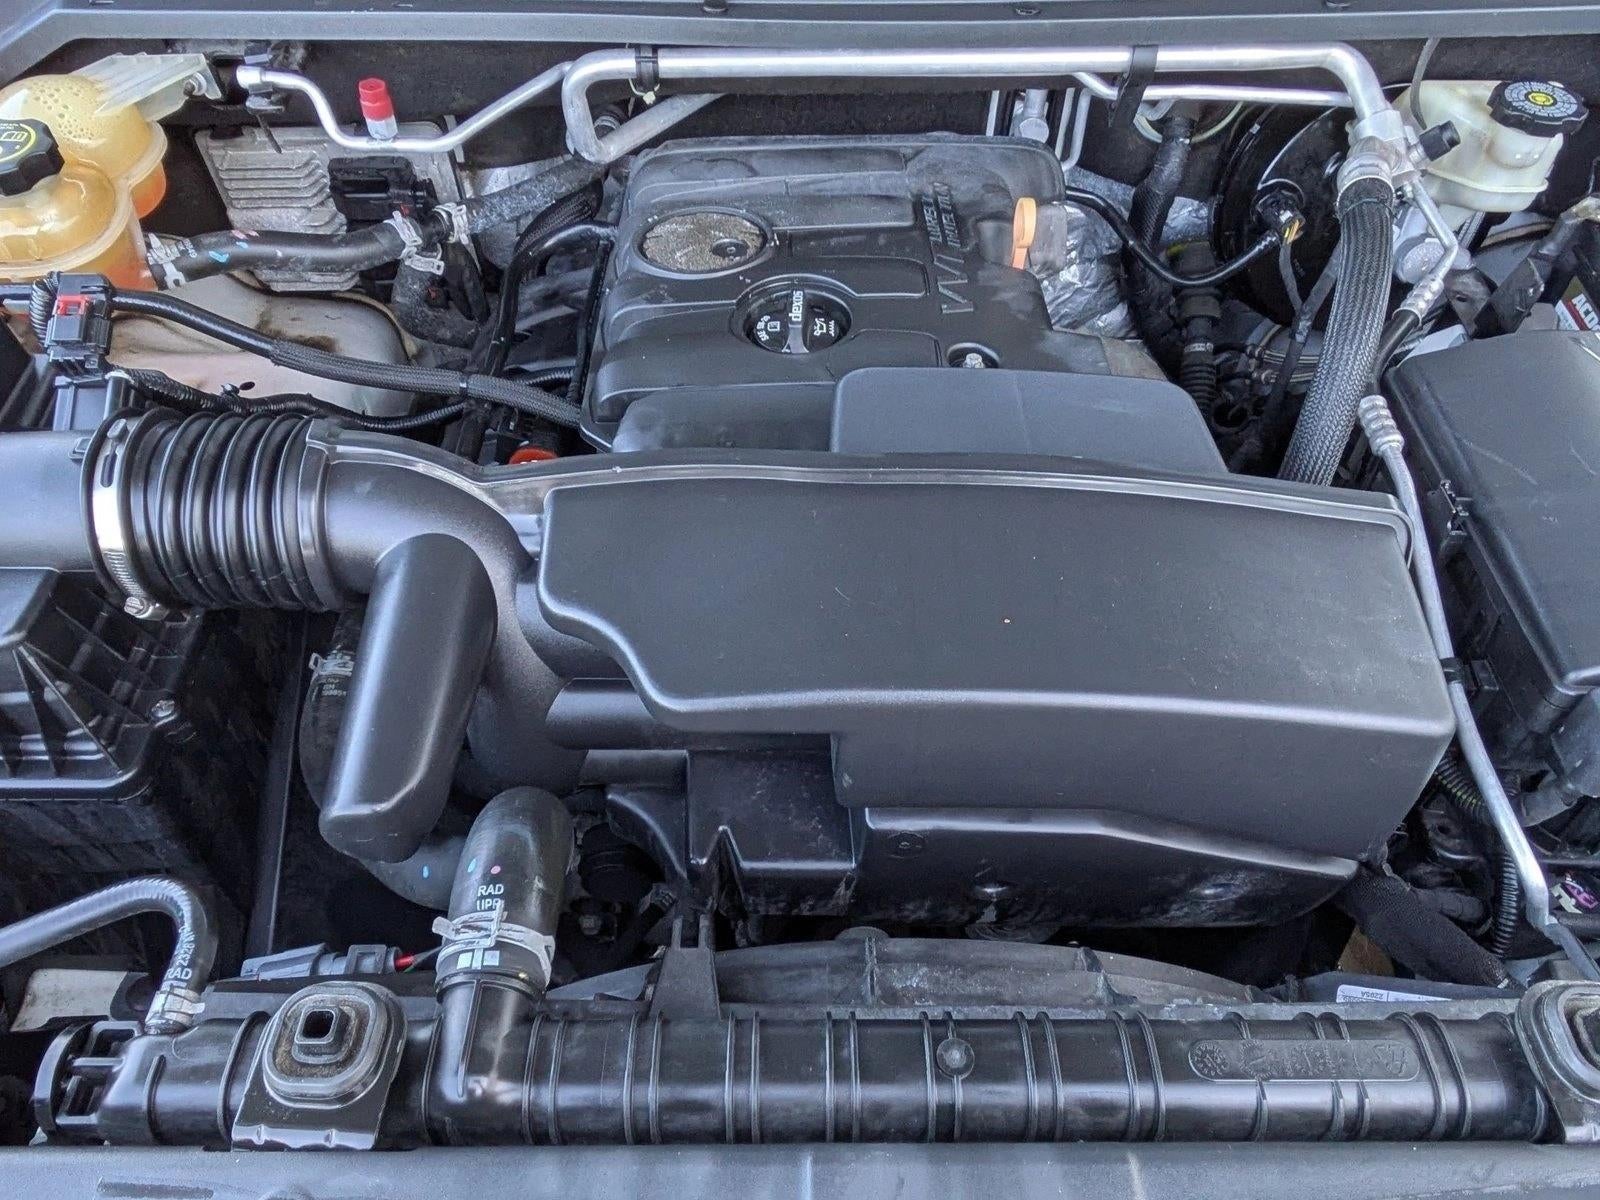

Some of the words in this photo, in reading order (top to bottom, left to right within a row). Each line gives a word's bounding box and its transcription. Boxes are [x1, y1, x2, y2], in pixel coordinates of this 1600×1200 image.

[788, 290, 804, 322] dexos
[477, 883, 505, 897] RAD
[164, 967, 193, 981] RAD
